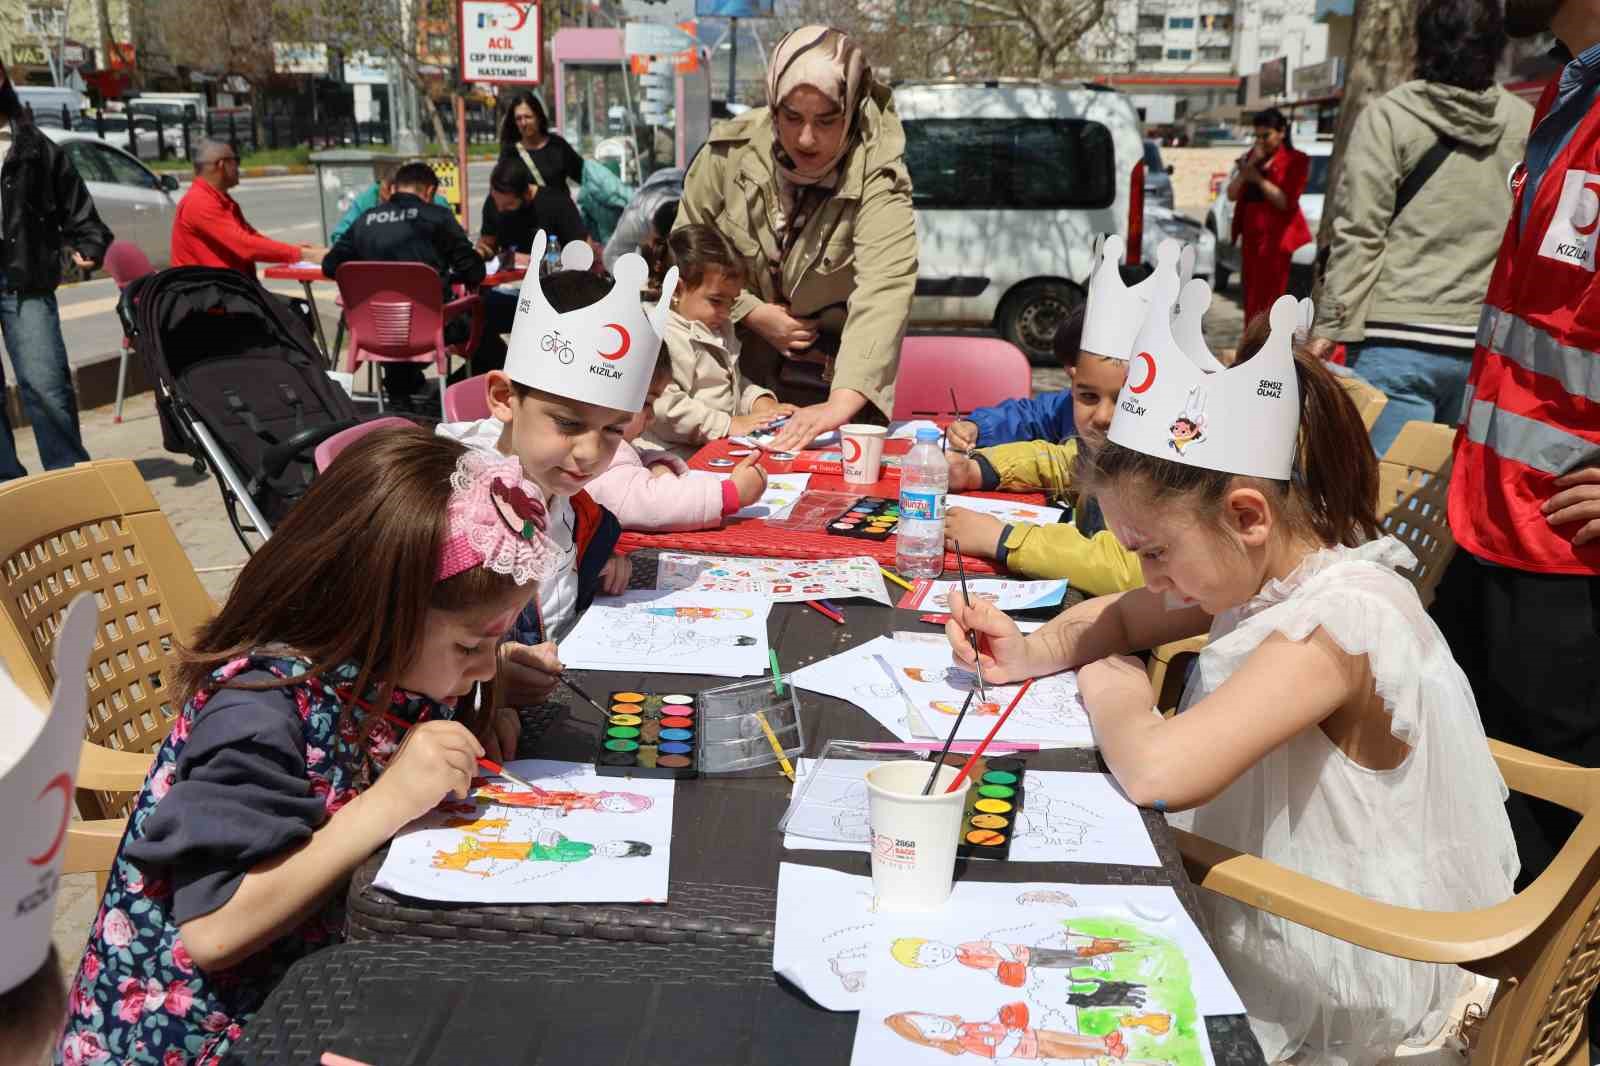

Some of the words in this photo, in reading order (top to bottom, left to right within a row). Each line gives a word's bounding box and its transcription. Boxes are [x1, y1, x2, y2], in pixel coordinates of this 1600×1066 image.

[488, 34, 513, 49] ACİL
[470, 53, 486, 63] CEP
[488, 53, 534, 64] TELEFONU
[478, 67, 528, 77] HASTANESİ
[589, 364, 624, 380] KIZILAY
[1257, 388, 1281, 399] OLMAZ
[1120, 401, 1147, 417] KIZILAY
[895, 838, 916, 848] 2868
